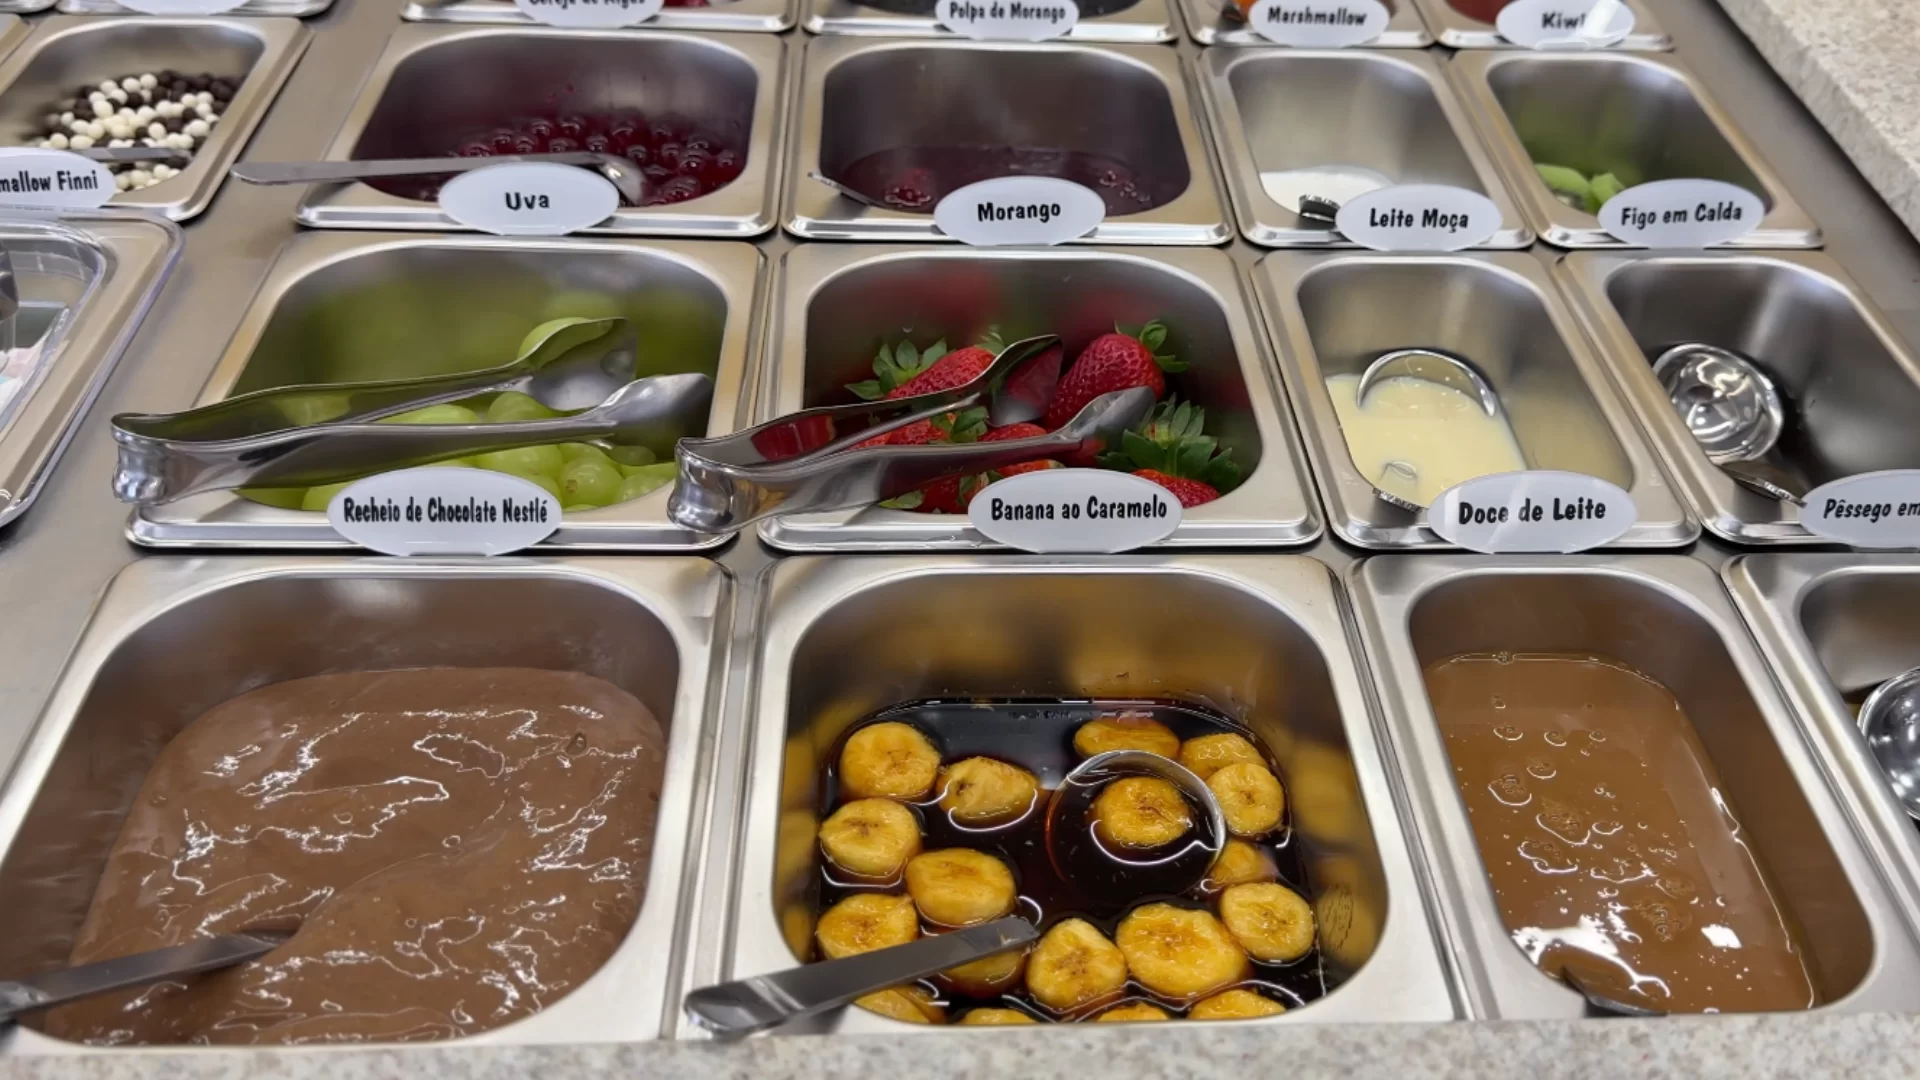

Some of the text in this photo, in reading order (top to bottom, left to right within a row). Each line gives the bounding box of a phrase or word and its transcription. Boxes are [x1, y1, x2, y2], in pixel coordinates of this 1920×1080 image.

[949, 2, 1066, 24] Polpa de Morango
[1267, 6, 1367, 26] Marshmallow
[56, 169, 99, 191] Finni
[505, 192, 550, 211] Uva
[977, 202, 1061, 223] Morango
[1369, 207, 1469, 233] Leite Moça
[1621, 201, 1742, 231] Figo em Calda
[343, 496, 548, 523] Recheio de Chocolate Nestlé
[990, 494, 1168, 521] Banana ao Caramelo
[1458, 497, 1606, 525] Doce de Leite
[1823, 498, 1920, 523] Pêssego em
